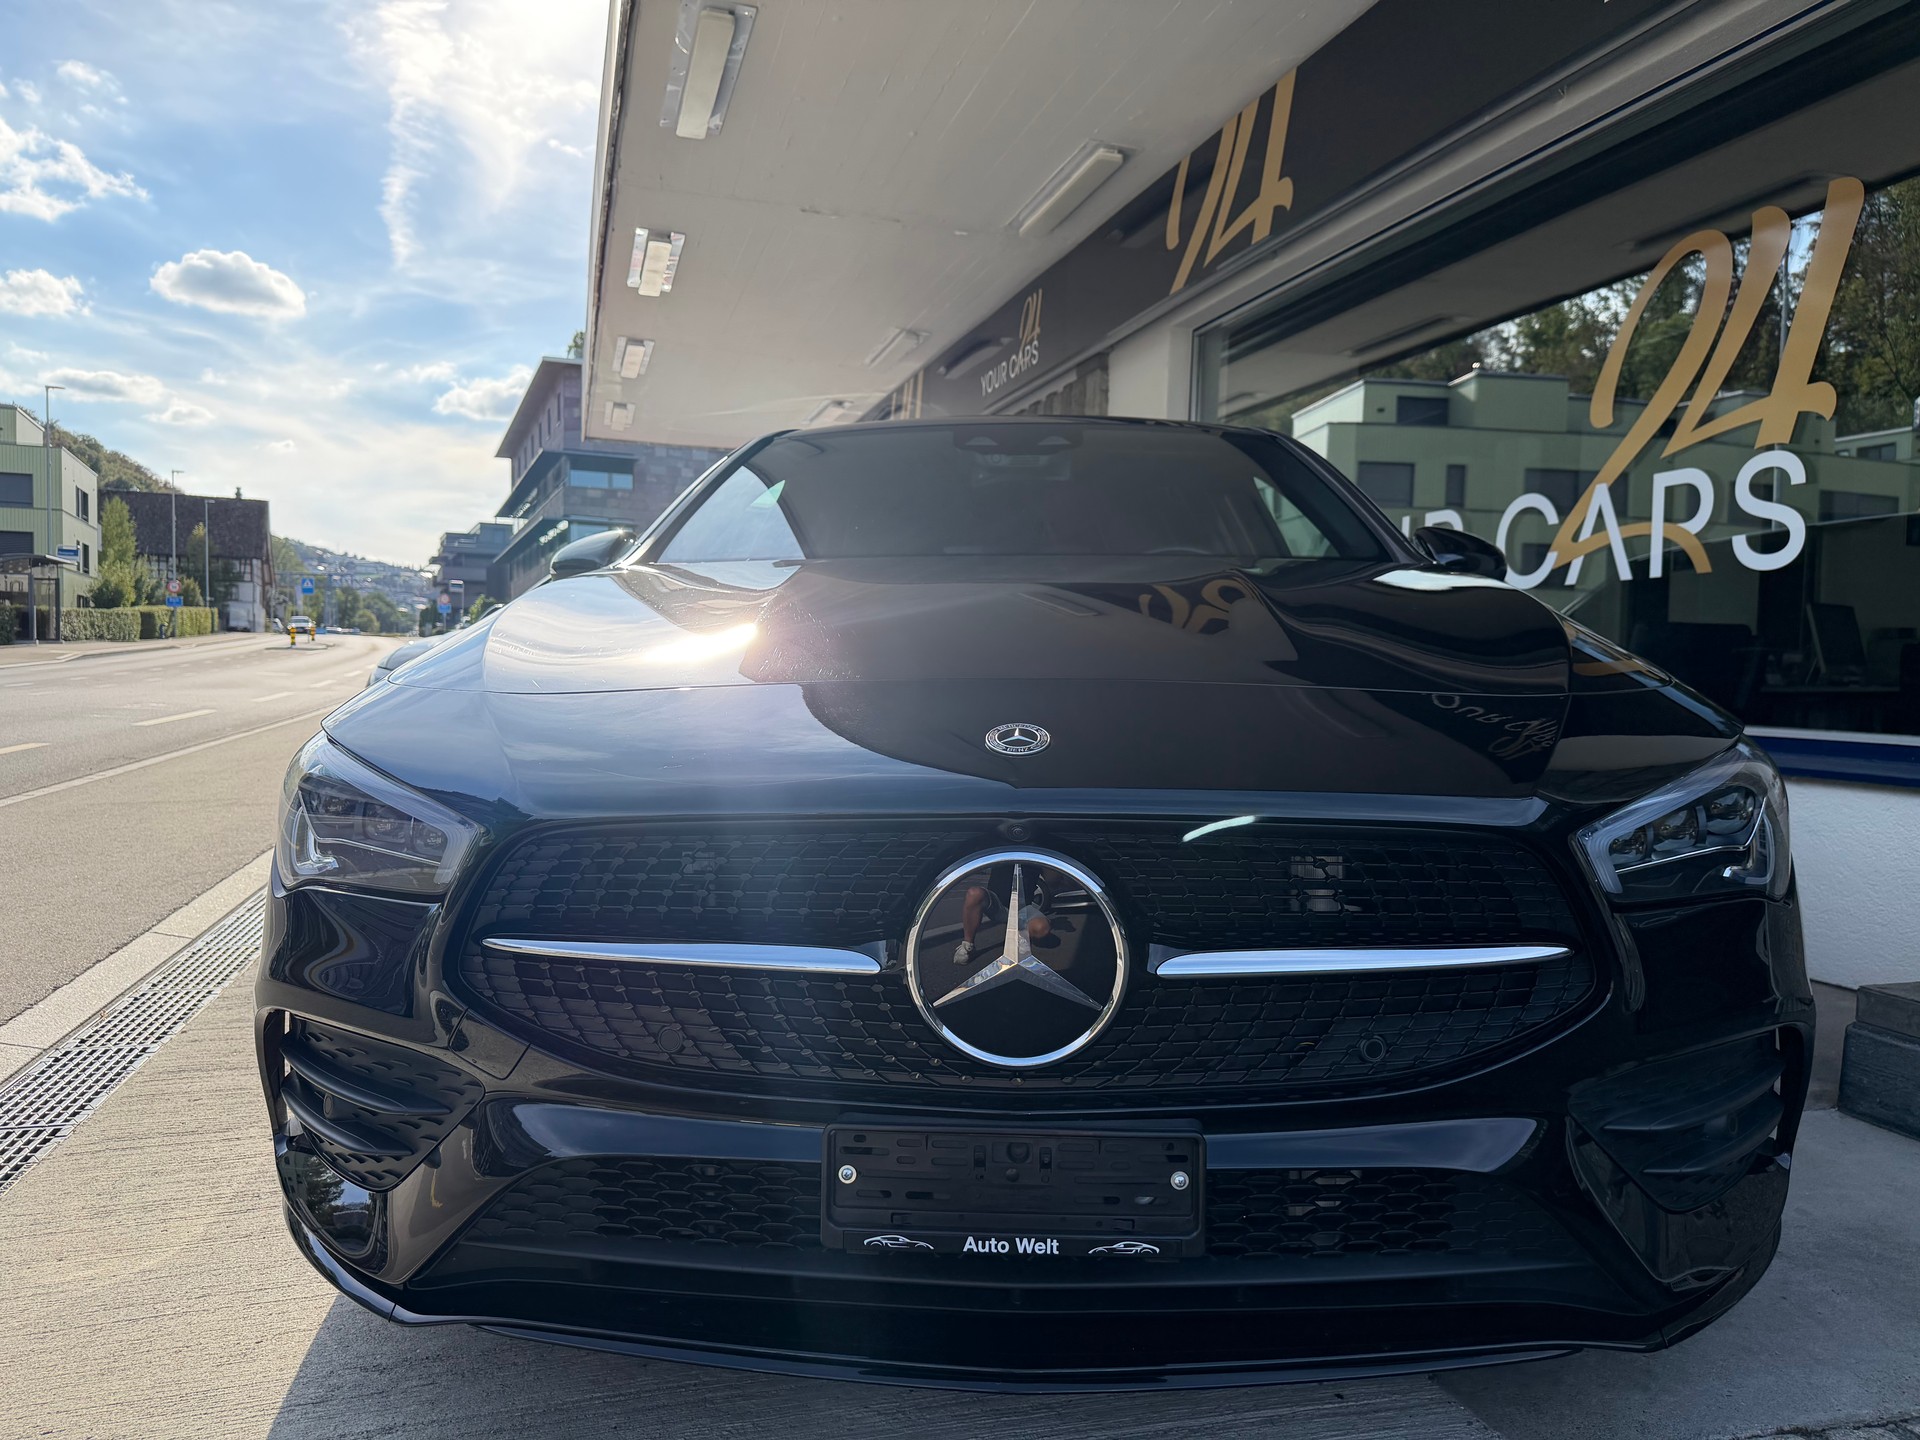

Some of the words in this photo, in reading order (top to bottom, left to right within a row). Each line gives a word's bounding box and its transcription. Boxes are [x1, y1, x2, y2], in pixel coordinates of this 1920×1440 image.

[981, 361, 1007, 397] YOUR
[1009, 340, 1039, 378] CARS
[1552, 177, 1865, 574] 24
[1496, 450, 1807, 590] CARS
[962, 1236, 1010, 1254] Auto
[1015, 1237, 1060, 1255] Welt
